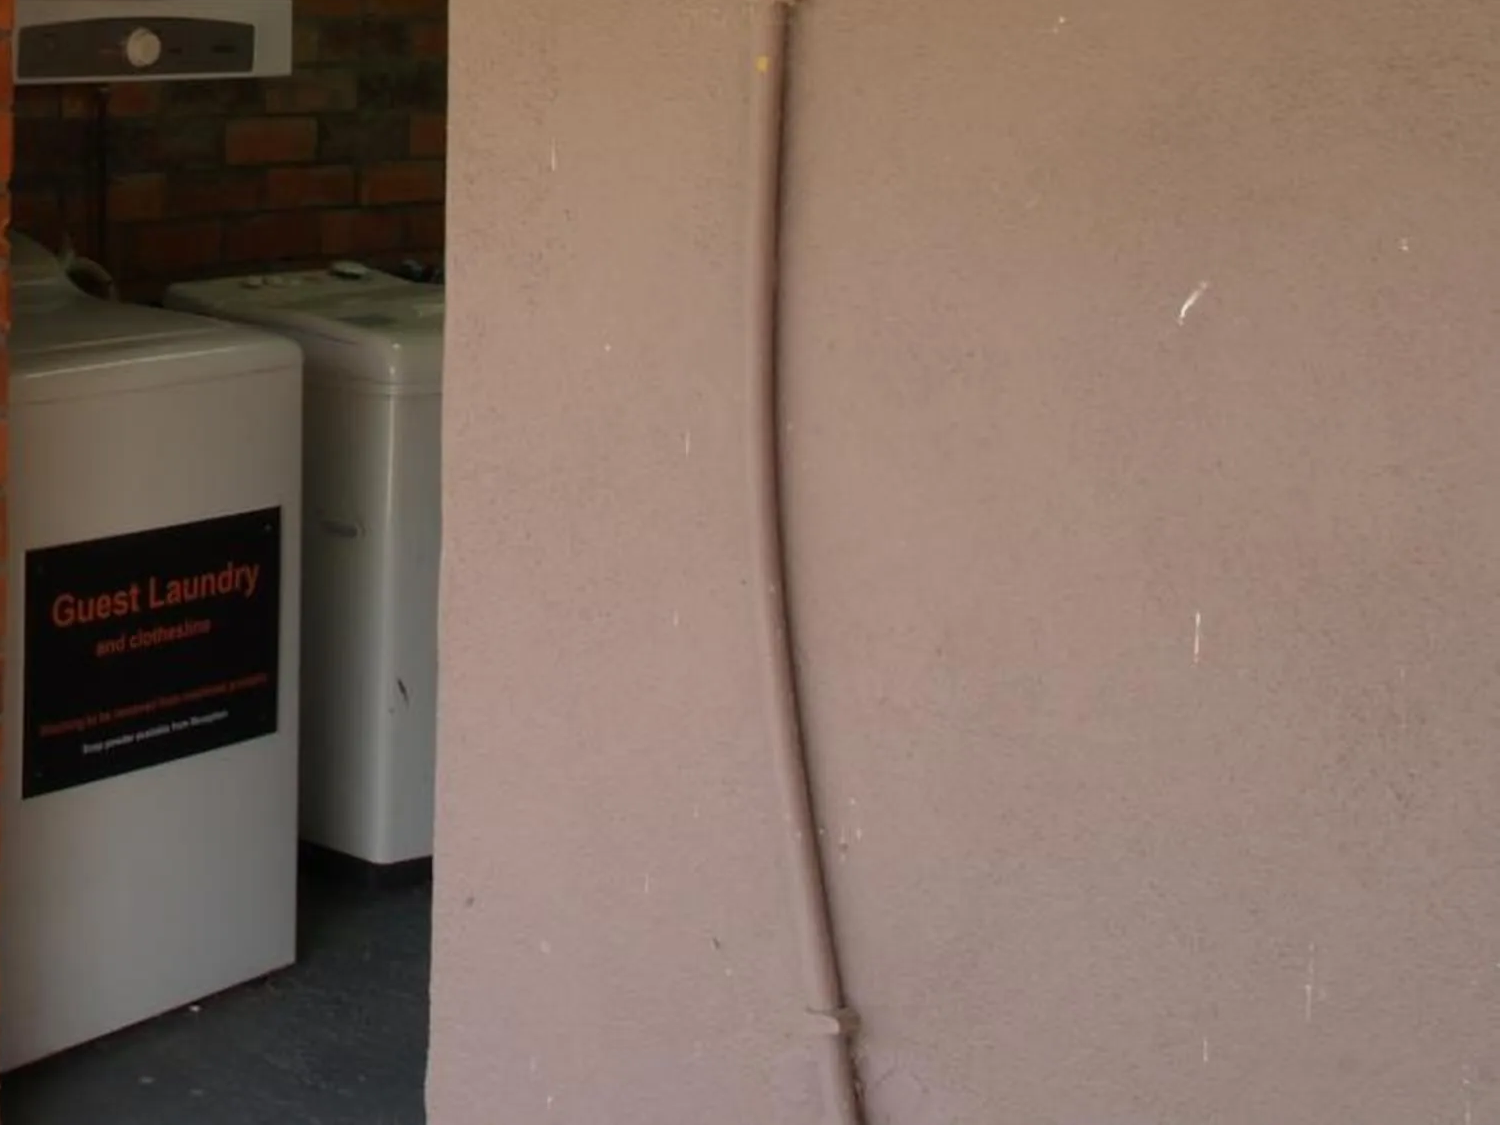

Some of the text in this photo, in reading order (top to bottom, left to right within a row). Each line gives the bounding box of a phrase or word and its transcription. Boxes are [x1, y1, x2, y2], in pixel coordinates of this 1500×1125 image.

[52, 561, 260, 627] Guest Laundry
[96, 634, 125, 657] and
